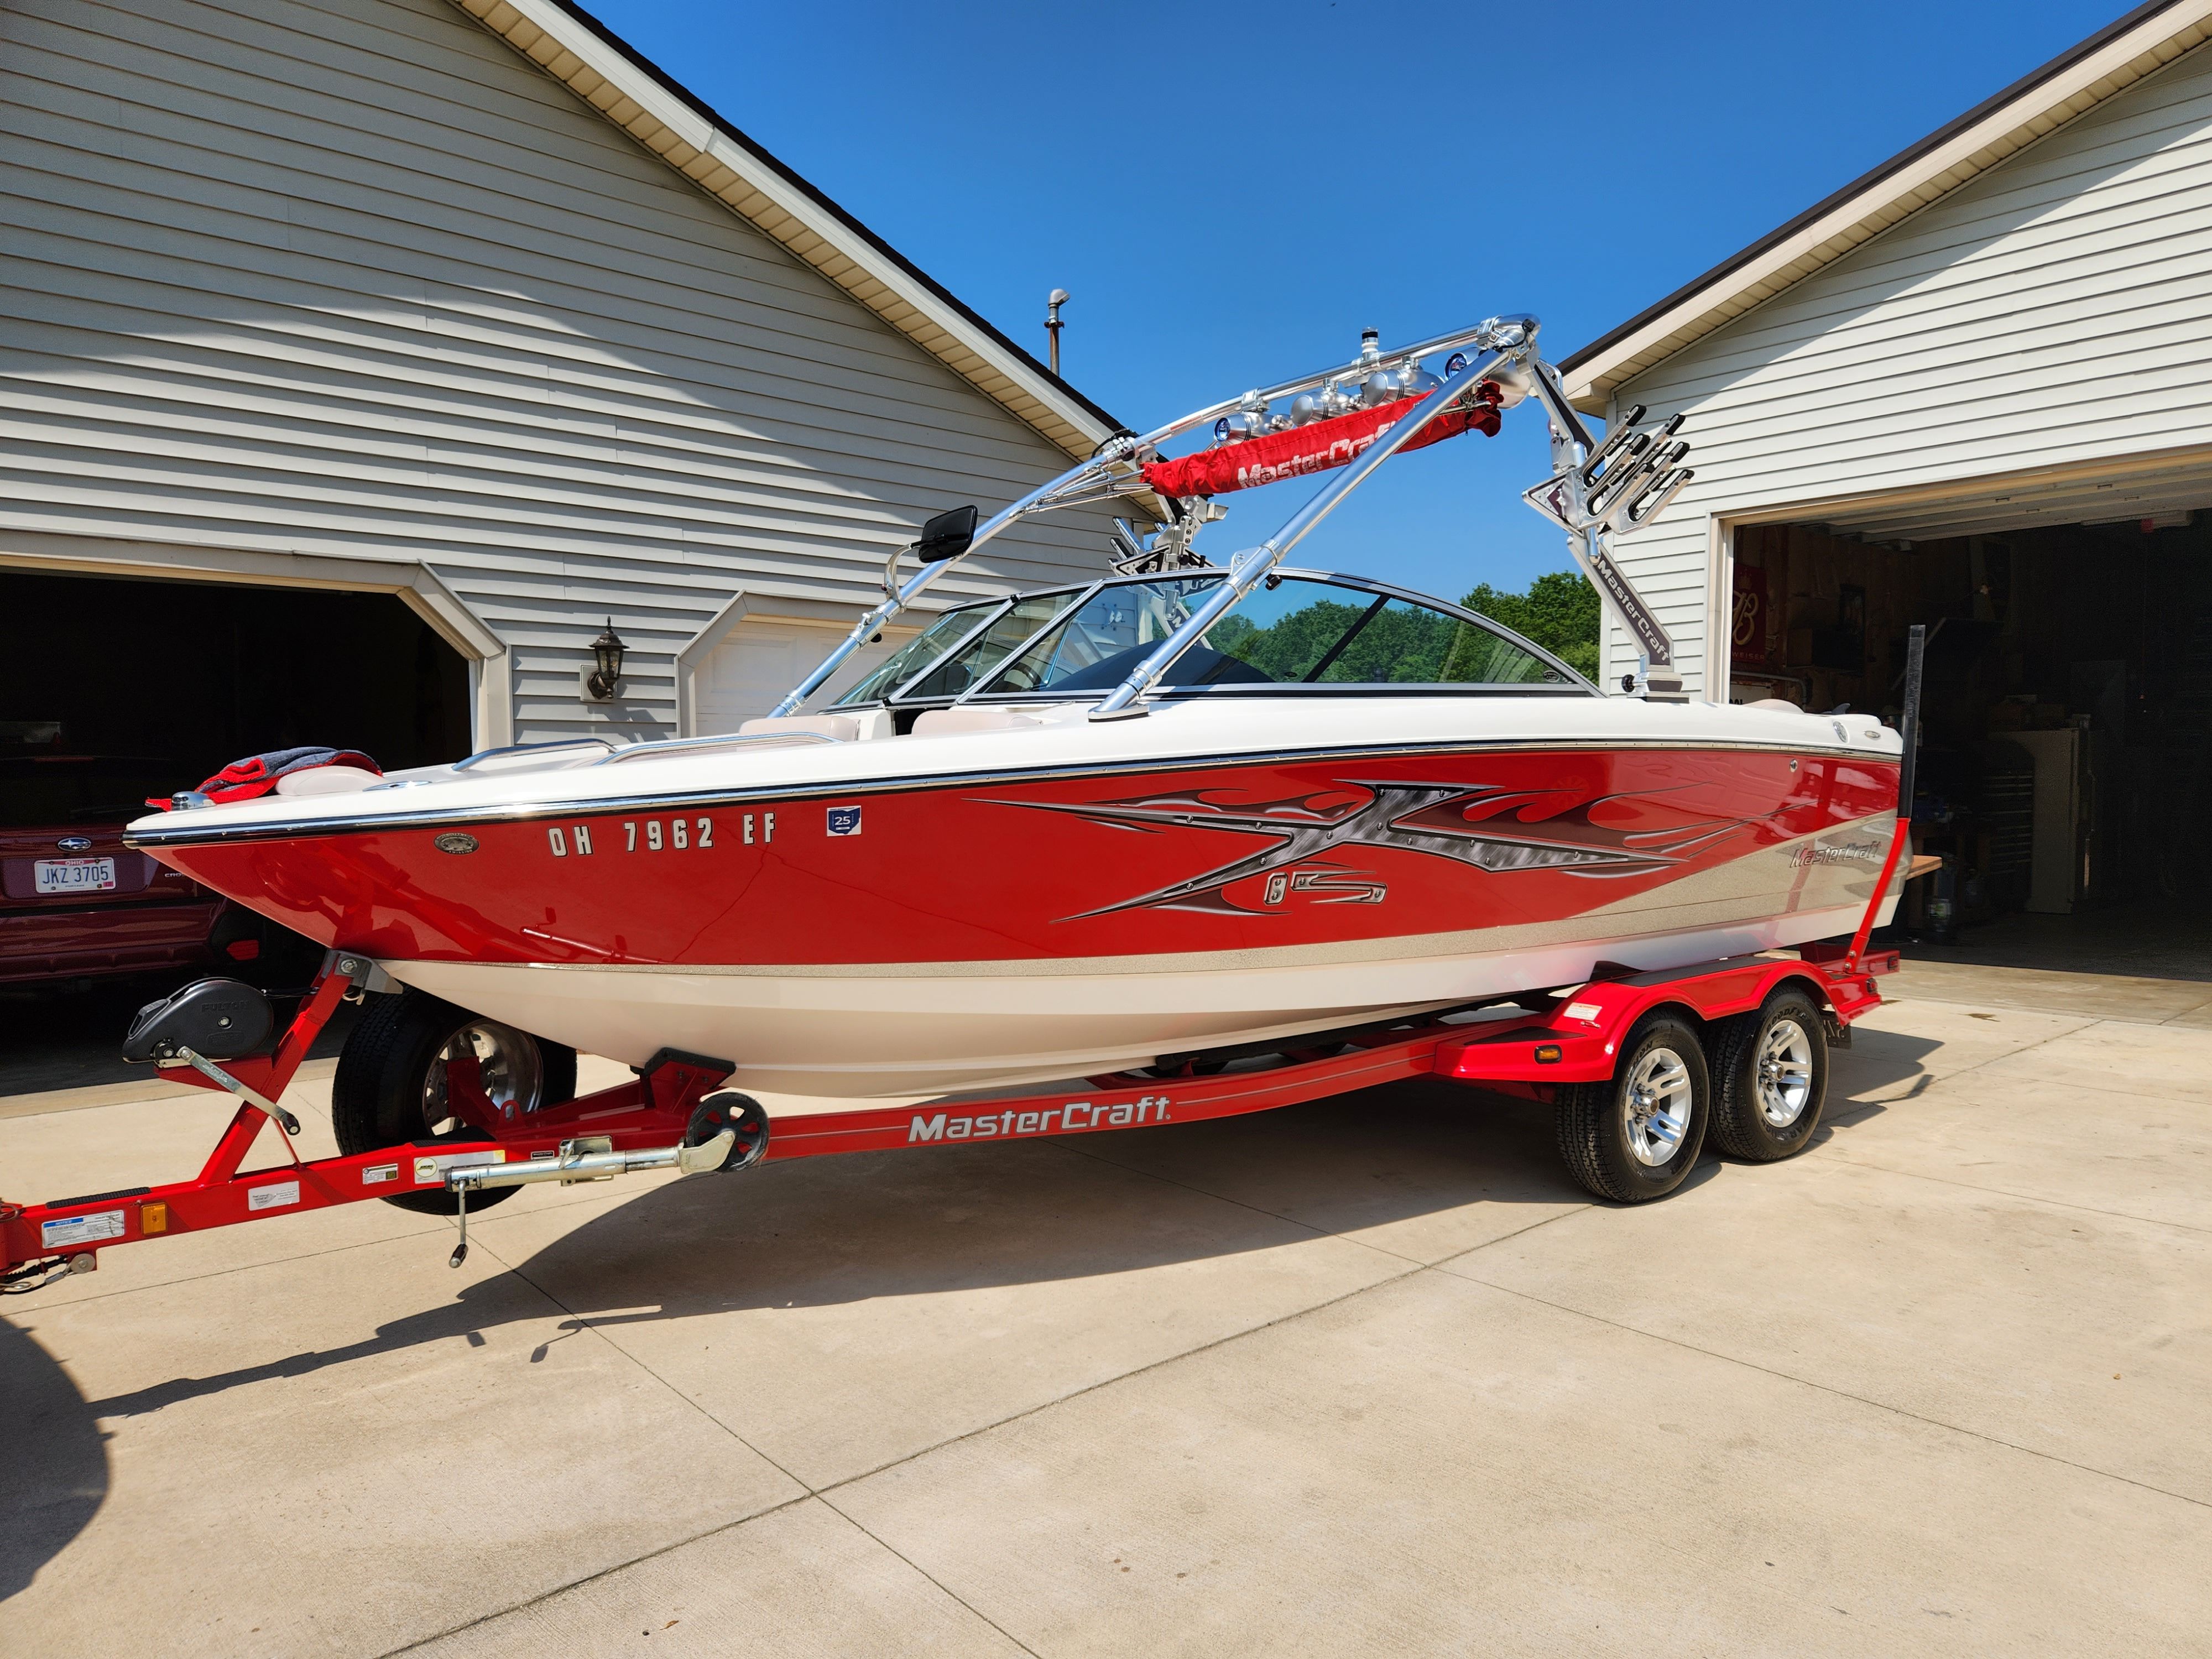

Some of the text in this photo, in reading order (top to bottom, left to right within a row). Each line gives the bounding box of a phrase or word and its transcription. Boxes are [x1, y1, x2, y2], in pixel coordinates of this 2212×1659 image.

[1238, 421, 1396, 489] MasterCraf
[1598, 560, 1669, 661] MasterCraft
[547, 812, 775, 858] OH 7962 EF
[834, 816, 851, 826] 25
[1790, 840, 1882, 868] MasterCraft
[42, 865, 109, 884] JKZ 3705
[201, 999, 249, 1013] FULTON
[908, 1096, 1170, 1142] MasterCraft
